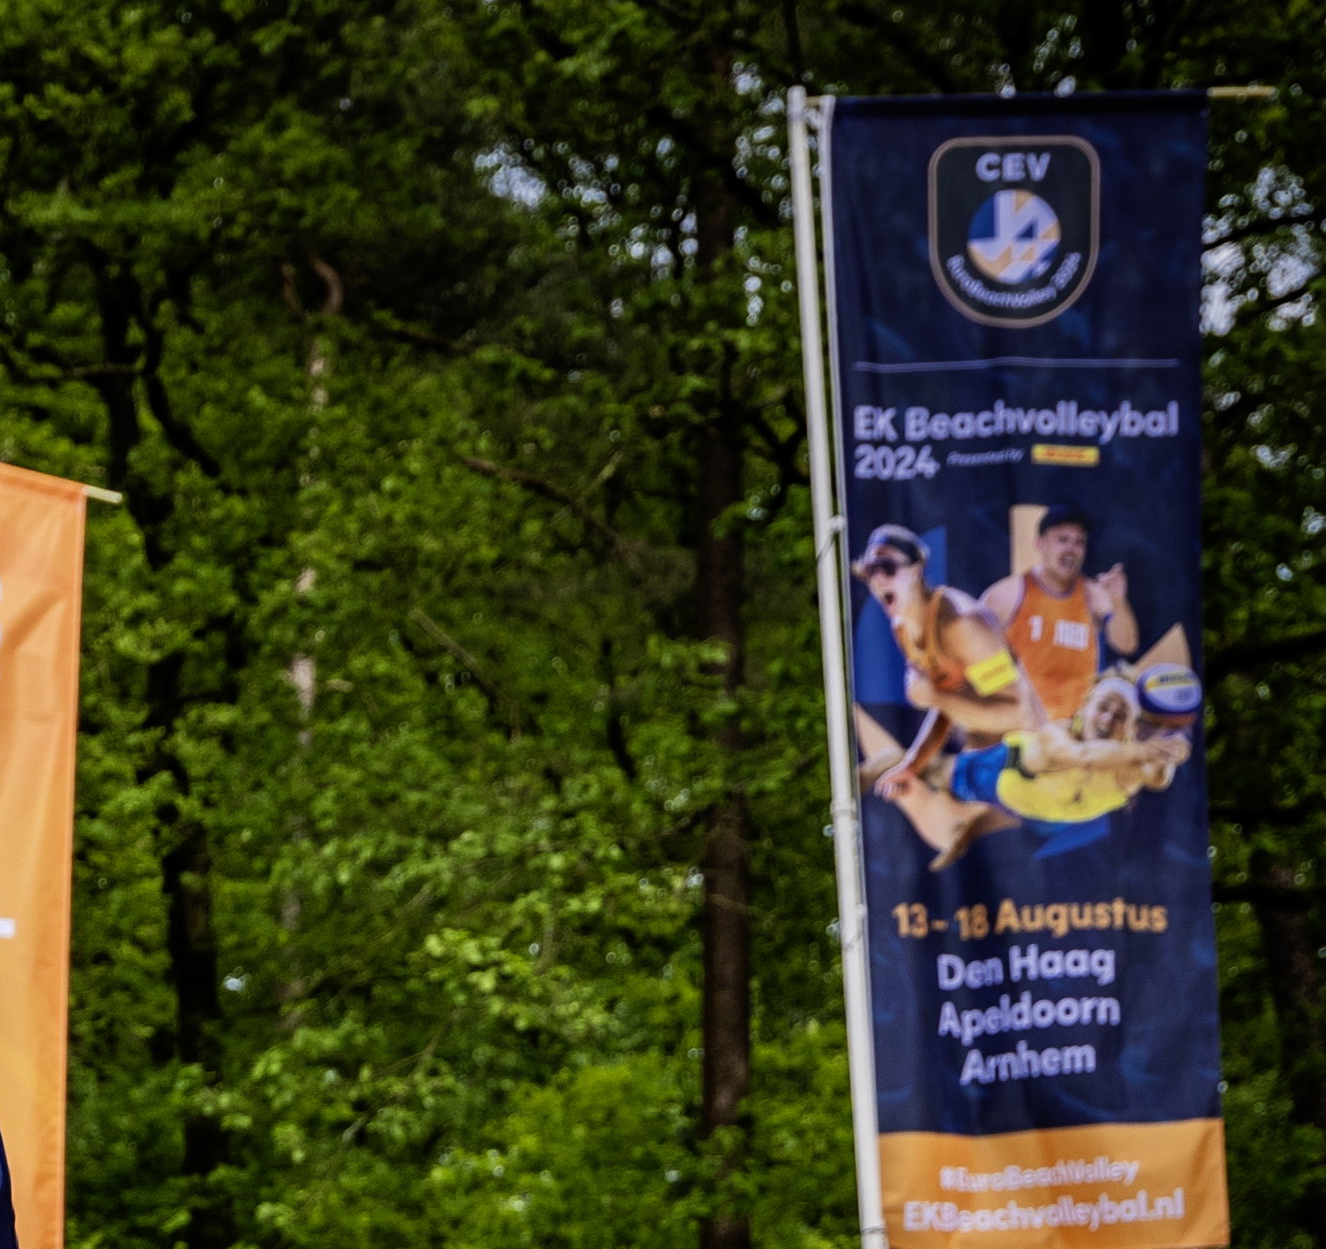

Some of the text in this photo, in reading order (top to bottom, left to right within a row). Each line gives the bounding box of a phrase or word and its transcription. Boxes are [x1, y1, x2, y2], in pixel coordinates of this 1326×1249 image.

[975, 152, 1052, 181] CEV
[854, 399, 1179, 445] EK Beachvolleybal
[854, 444, 940, 480] 2024
[892, 902, 929, 939] 13
[954, 904, 989, 941] 18
[994, 897, 1169, 938] Augustus
[937, 943, 1116, 991] Den Haag
[938, 990, 1121, 1047] Apeldoorn
[959, 1040, 1097, 1086] Arnhem
[903, 1187, 1186, 1234] EKBeachvolleybal.nl
